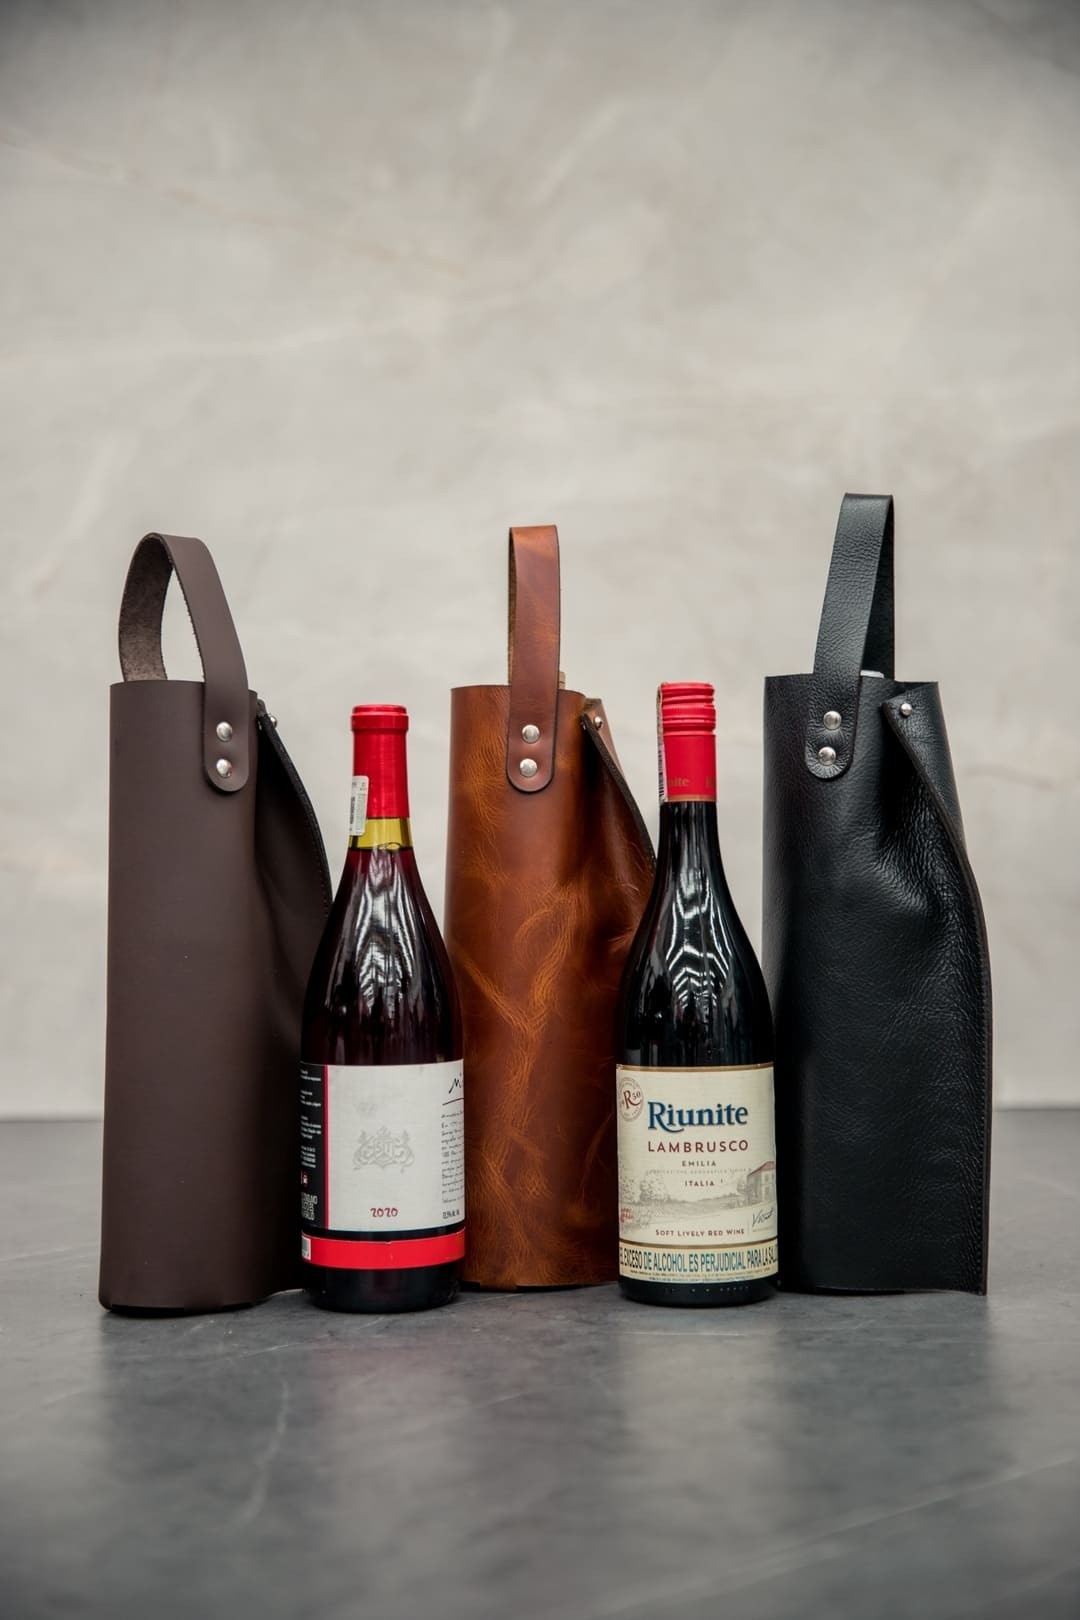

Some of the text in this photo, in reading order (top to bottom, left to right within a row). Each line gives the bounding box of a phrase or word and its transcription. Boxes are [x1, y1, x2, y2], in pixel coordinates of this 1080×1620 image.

[647, 1102, 749, 1133] Riunite
[648, 1140, 749, 1153] LAMBRUSCO
[682, 1160, 717, 1168] EMILIA
[684, 1180, 715, 1188] ITALIA
[370, 1207, 398, 1218] 2020
[655, 1228, 745, 1237] SOFT LIVELY RED WINE
[624, 1247, 643, 1269] EXCESO
[643, 1251, 652, 1271] DE
[653, 1252, 687, 1273] ALCOHOL
[689, 1252, 698, 1272] ES
[700, 1250, 746, 1272] PERJUDICIAL
[747, 1248, 762, 1269] PARA
[762, 1247, 768, 1266] LA
